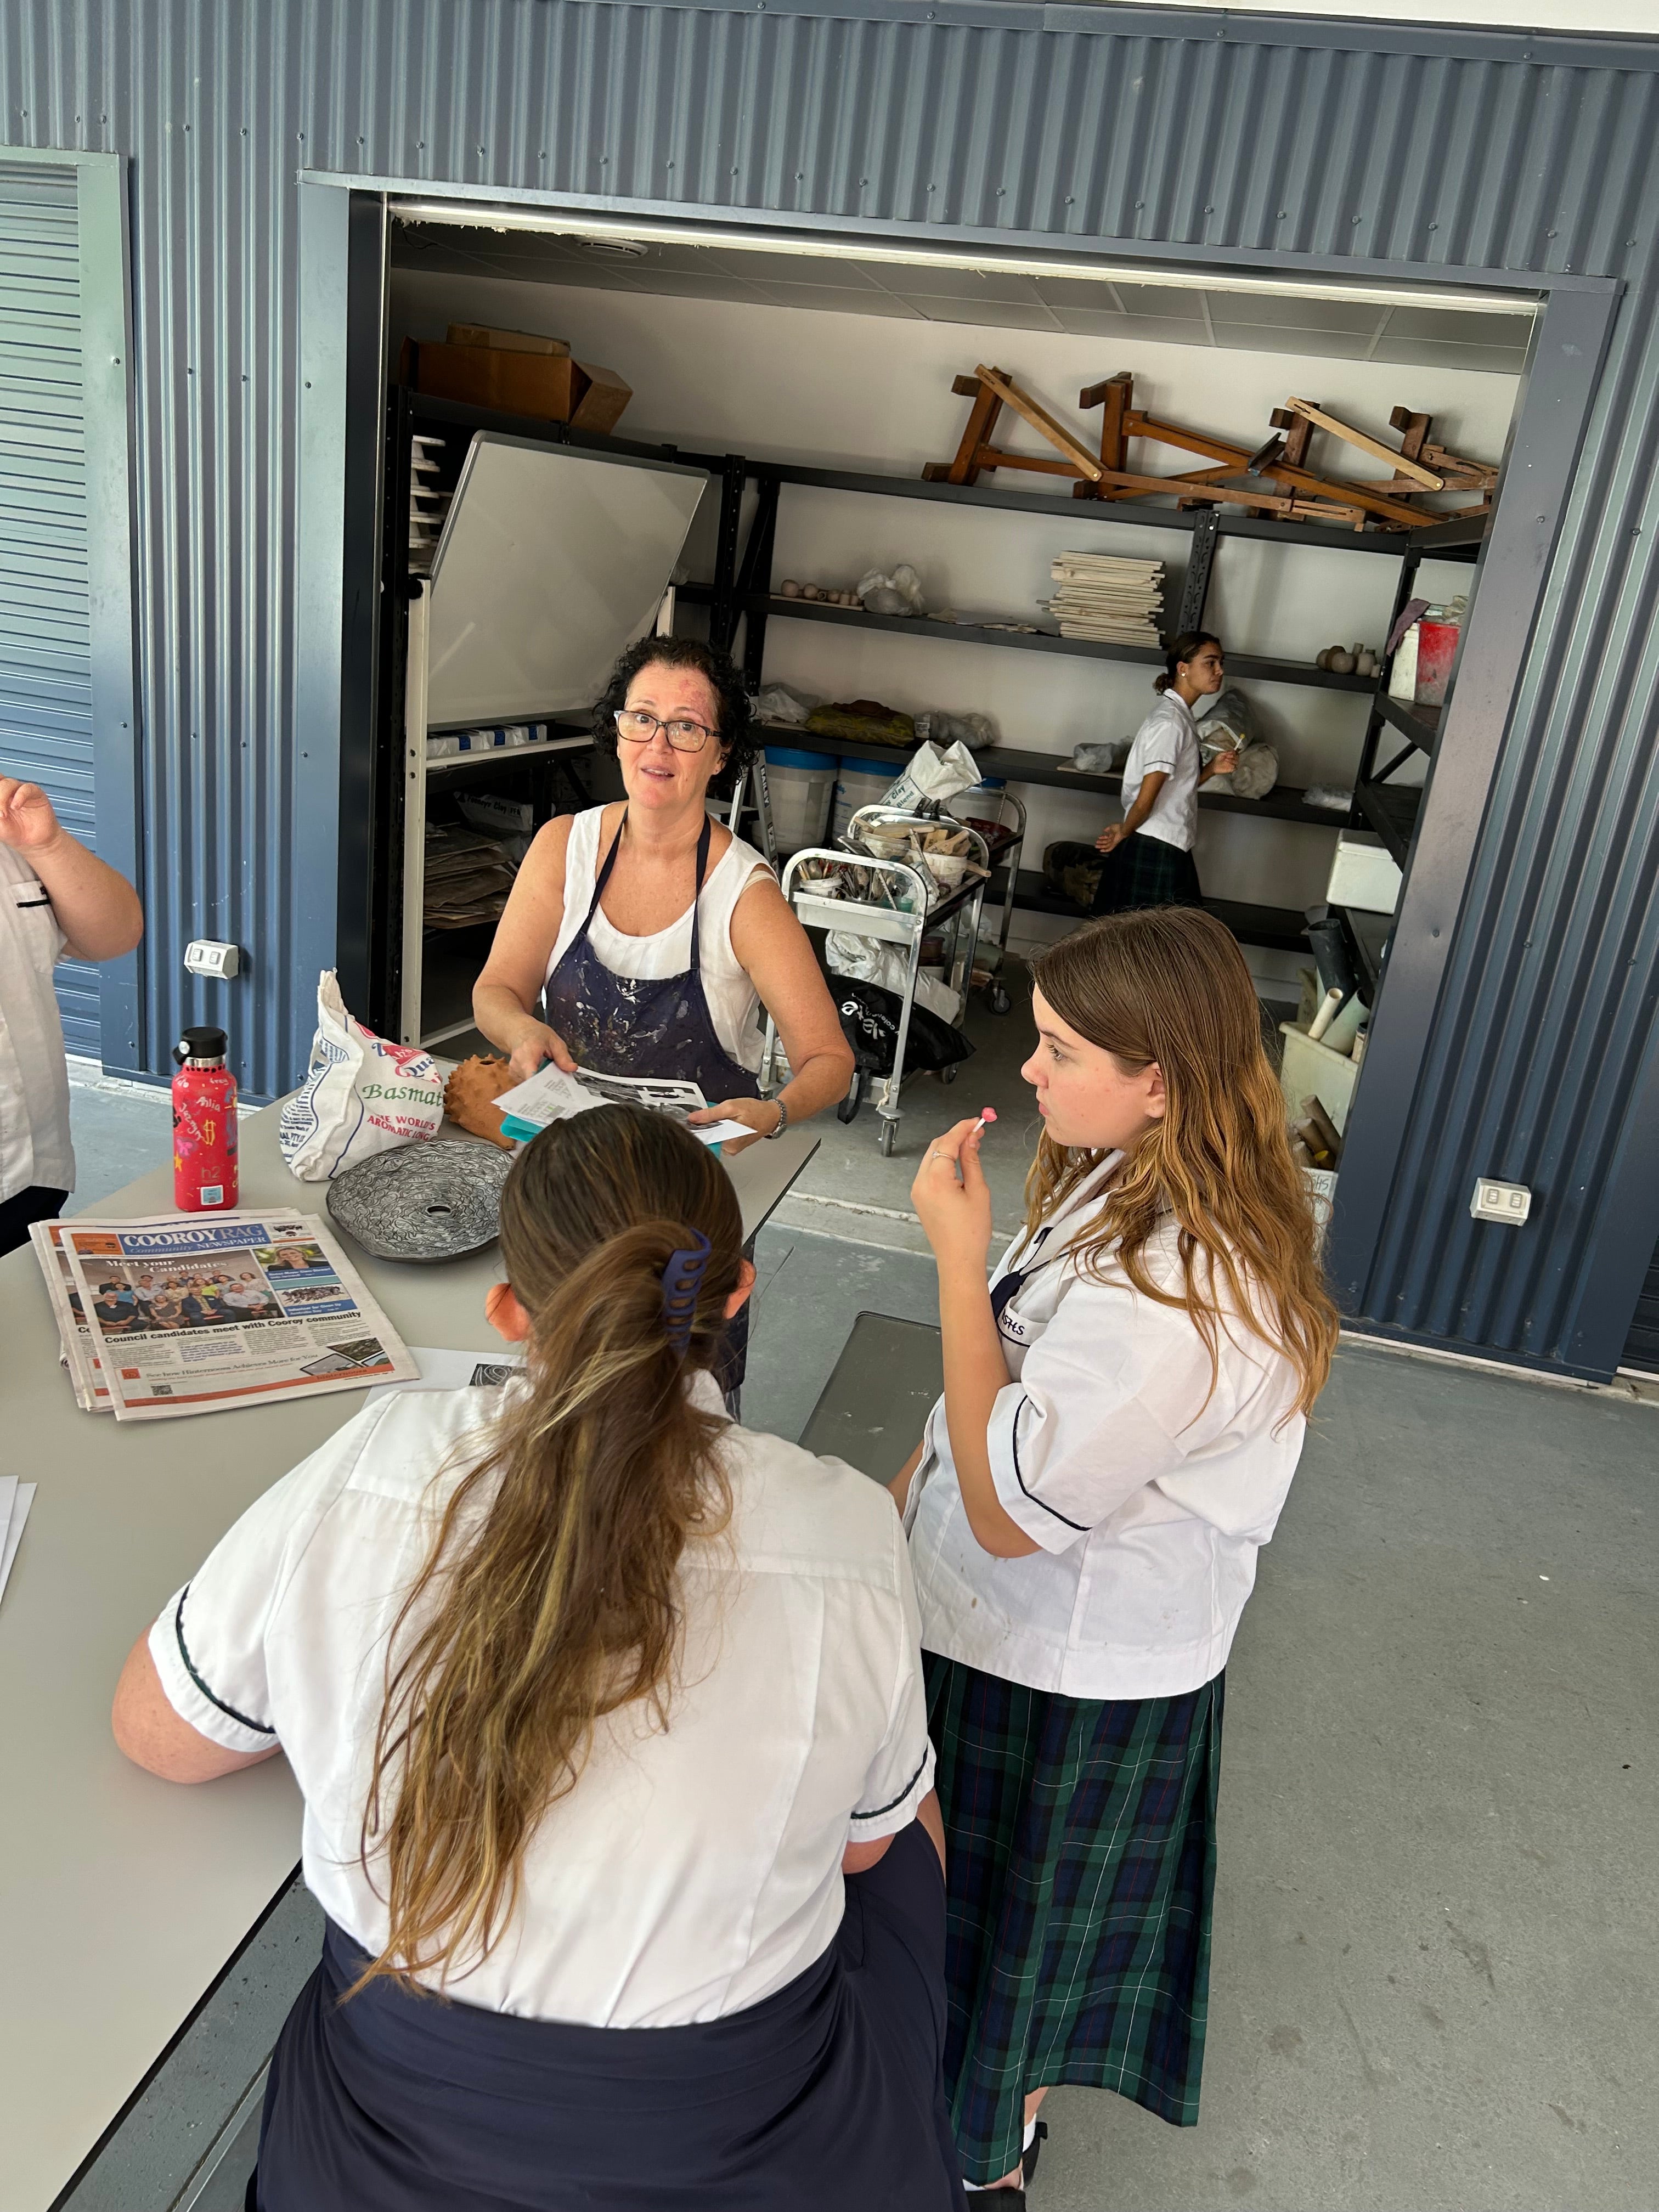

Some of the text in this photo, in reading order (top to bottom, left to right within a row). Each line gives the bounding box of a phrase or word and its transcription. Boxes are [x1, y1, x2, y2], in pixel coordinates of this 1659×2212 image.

[891, 785, 906, 799] Clay
[896, 791, 915, 808] Blend
[493, 801, 507, 814] Clay
[367, 1115, 413, 1137] AROMATIC
[396, 1116, 436, 1131] WORLD'S
[123, 1229, 217, 1246] COOROY
[219, 1225, 263, 1239] RAG
[130, 1245, 193, 1254] Community
[197, 1237, 266, 1249] NEWSPAPER
[149, 1262, 228, 1273] Candidates
[105, 1334, 147, 1343] Council
[150, 1329, 210, 1339] candidates
[268, 1318, 303, 1327] Cooroy
[306, 1311, 361, 1323] community
